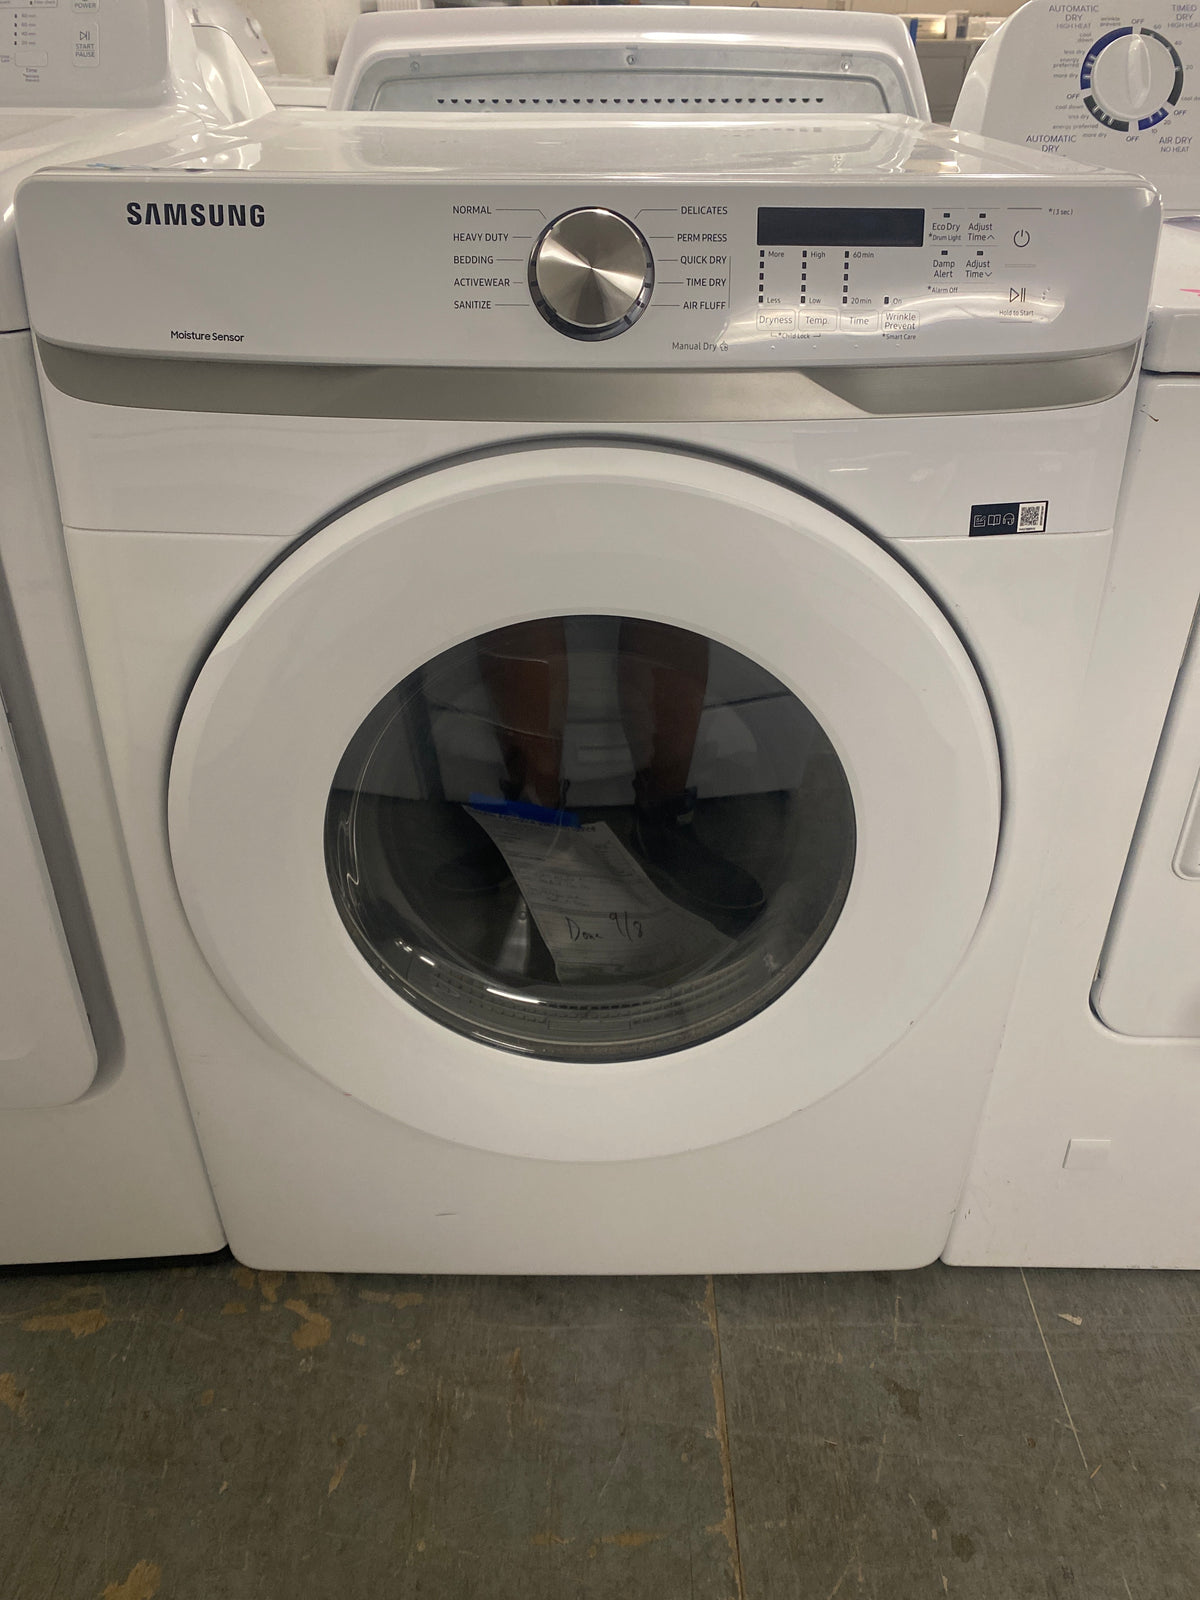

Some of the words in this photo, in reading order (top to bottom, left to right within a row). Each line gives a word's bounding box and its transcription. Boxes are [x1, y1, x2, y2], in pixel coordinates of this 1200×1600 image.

[126, 202, 266, 227] SAMSUNG
[452, 205, 492, 215] NORMAL
[680, 206, 728, 215] DELICATES
[968, 223, 993, 233] Adjust
[453, 233, 484, 242] HEAVY
[485, 233, 509, 242] DUTY
[677, 233, 701, 242] PERM
[702, 233, 728, 242] PRESS
[968, 233, 987, 241] Time
[811, 251, 826, 259] High
[453, 256, 494, 265] BEDDING
[680, 256, 707, 265] QUICK
[709, 256, 727, 264] DRY
[933, 260, 955, 269] Damp
[966, 260, 990, 269] Adjust
[934, 270, 953, 278] Alert
[965, 270, 984, 278] Time
[453, 278, 510, 287] ACTIVEWEAR
[686, 278, 707, 287] TIME
[709, 278, 727, 287] DRY
[454, 300, 492, 310] SANITIZE
[683, 301, 698, 310] AIR
[700, 301, 727, 310] FLUFF
[759, 315, 793, 326] Dryness
[849, 316, 869, 325] Time
[885, 312, 916, 321] Wrinkle
[885, 322, 916, 330] Prevent
[170, 330, 211, 340] Moisture
[212, 332, 245, 342] Sensor
[672, 341, 701, 351] Manual
[703, 342, 717, 352] Dry
[608, 911, 644, 942] 9/8
